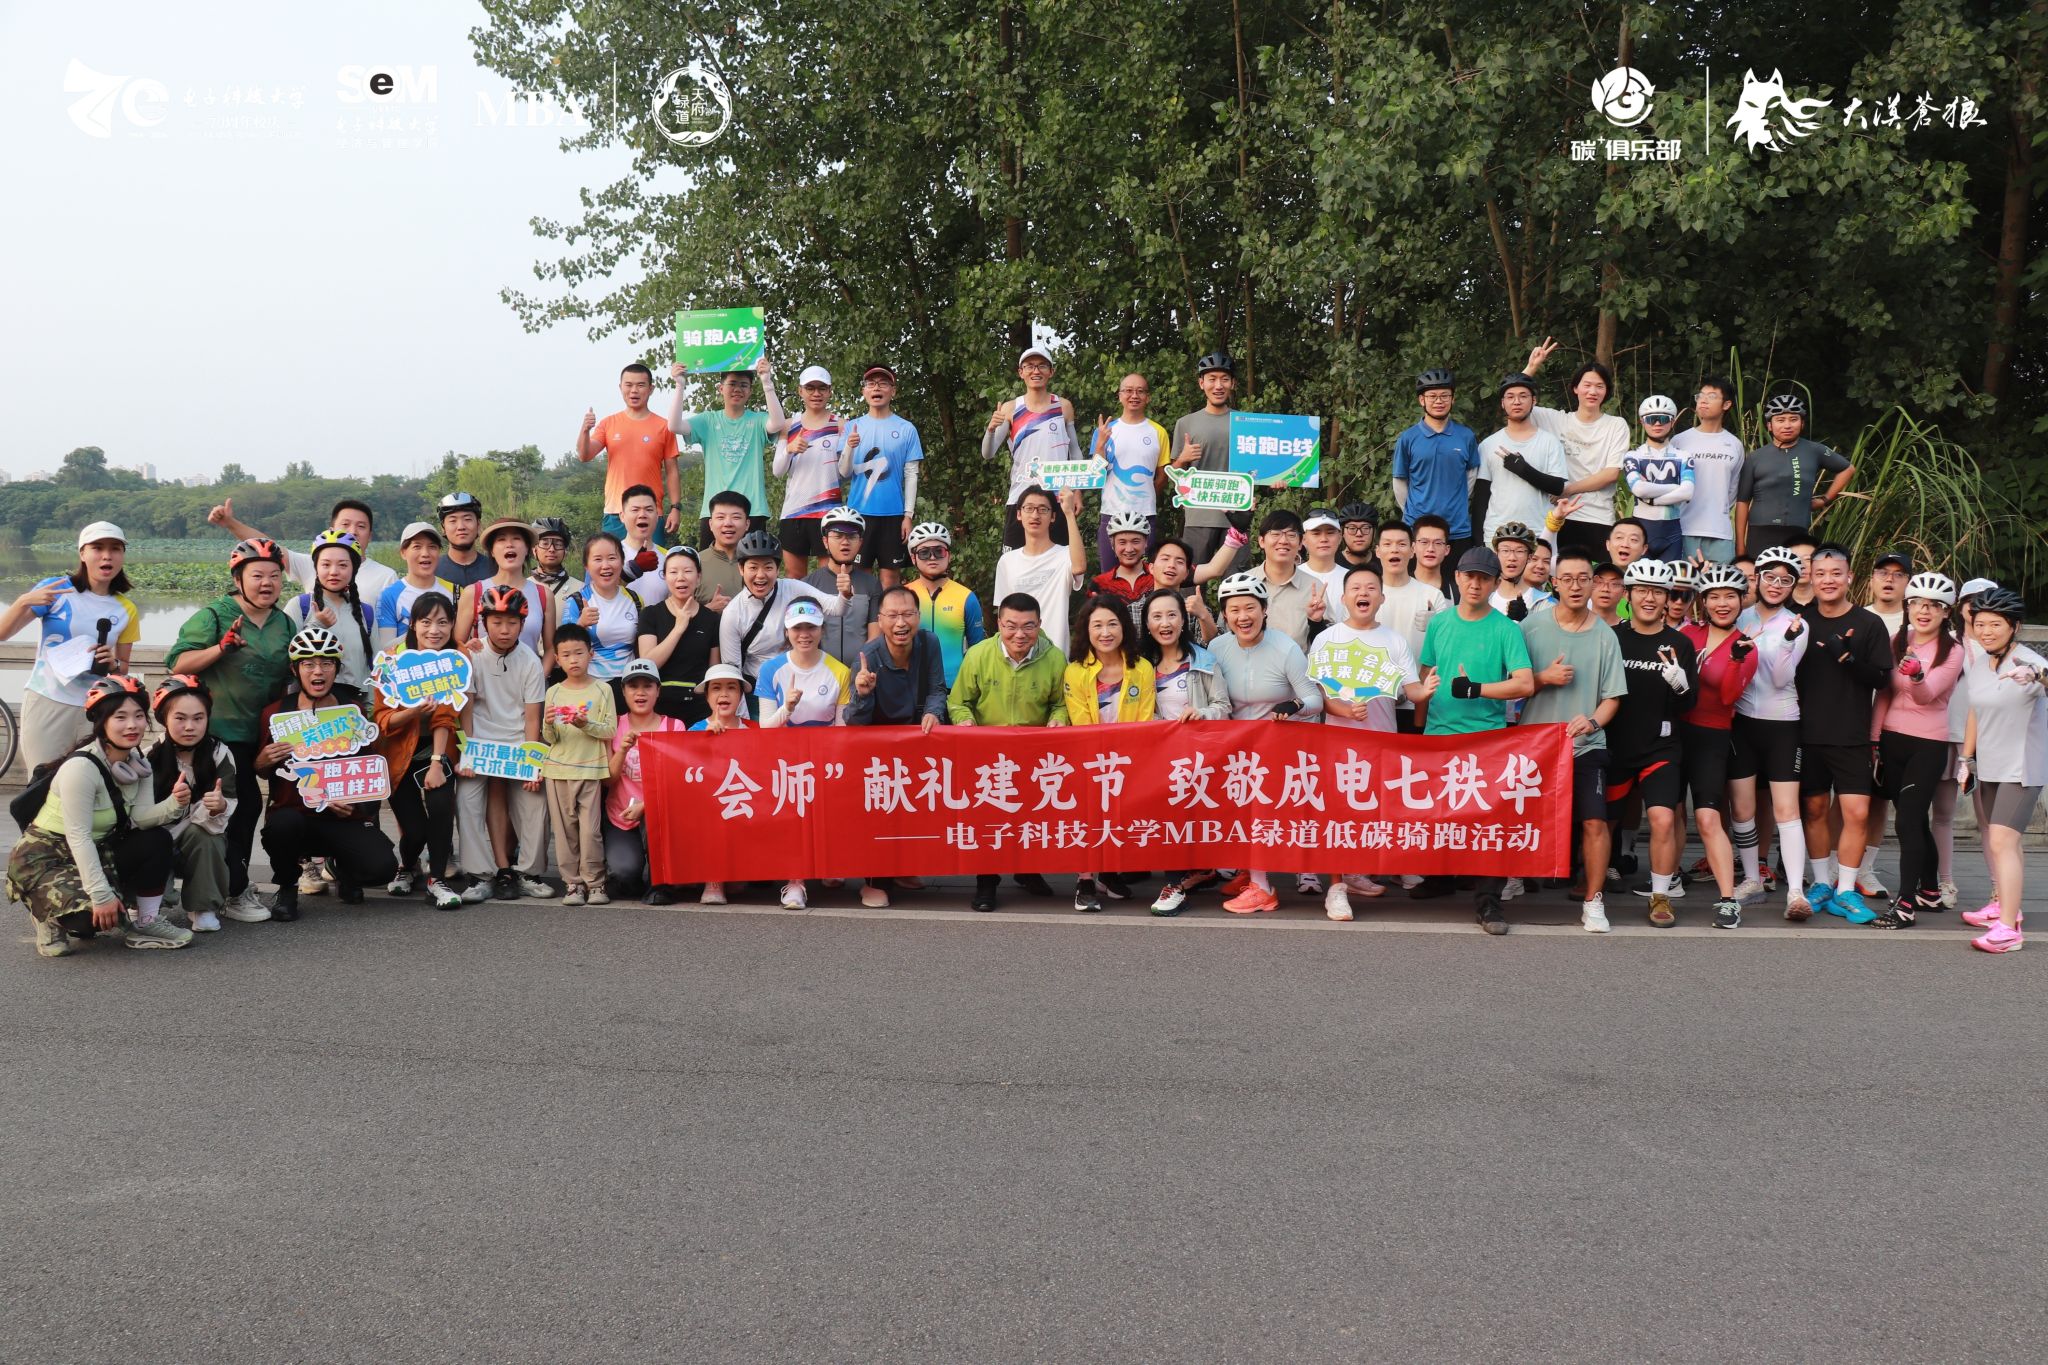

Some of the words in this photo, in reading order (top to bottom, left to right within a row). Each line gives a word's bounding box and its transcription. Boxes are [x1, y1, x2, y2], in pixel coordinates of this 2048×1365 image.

[683, 327, 758, 347] 骑跑A线
[1237, 435, 1313, 457] 骑跑B线
[1191, 477, 1239, 491] 低碳骑跑
[1197, 491, 1246, 504] 快乐就好
[394, 657, 453, 684] 跑得再慢
[406, 674, 464, 699] 也是献礼
[269, 710, 319, 741] 骑得慢
[301, 716, 351, 747] 笑得欢
[465, 741, 527, 763] 不求最快
[323, 758, 384, 778] 跑不动
[473, 757, 534, 779] 只求最帅
[327, 777, 386, 800] 照样冲
[684, 758, 844, 819] “会师”
[863, 751, 1132, 813] 献礼建党节
[1167, 748, 1543, 816] 致敬成电七秩华
